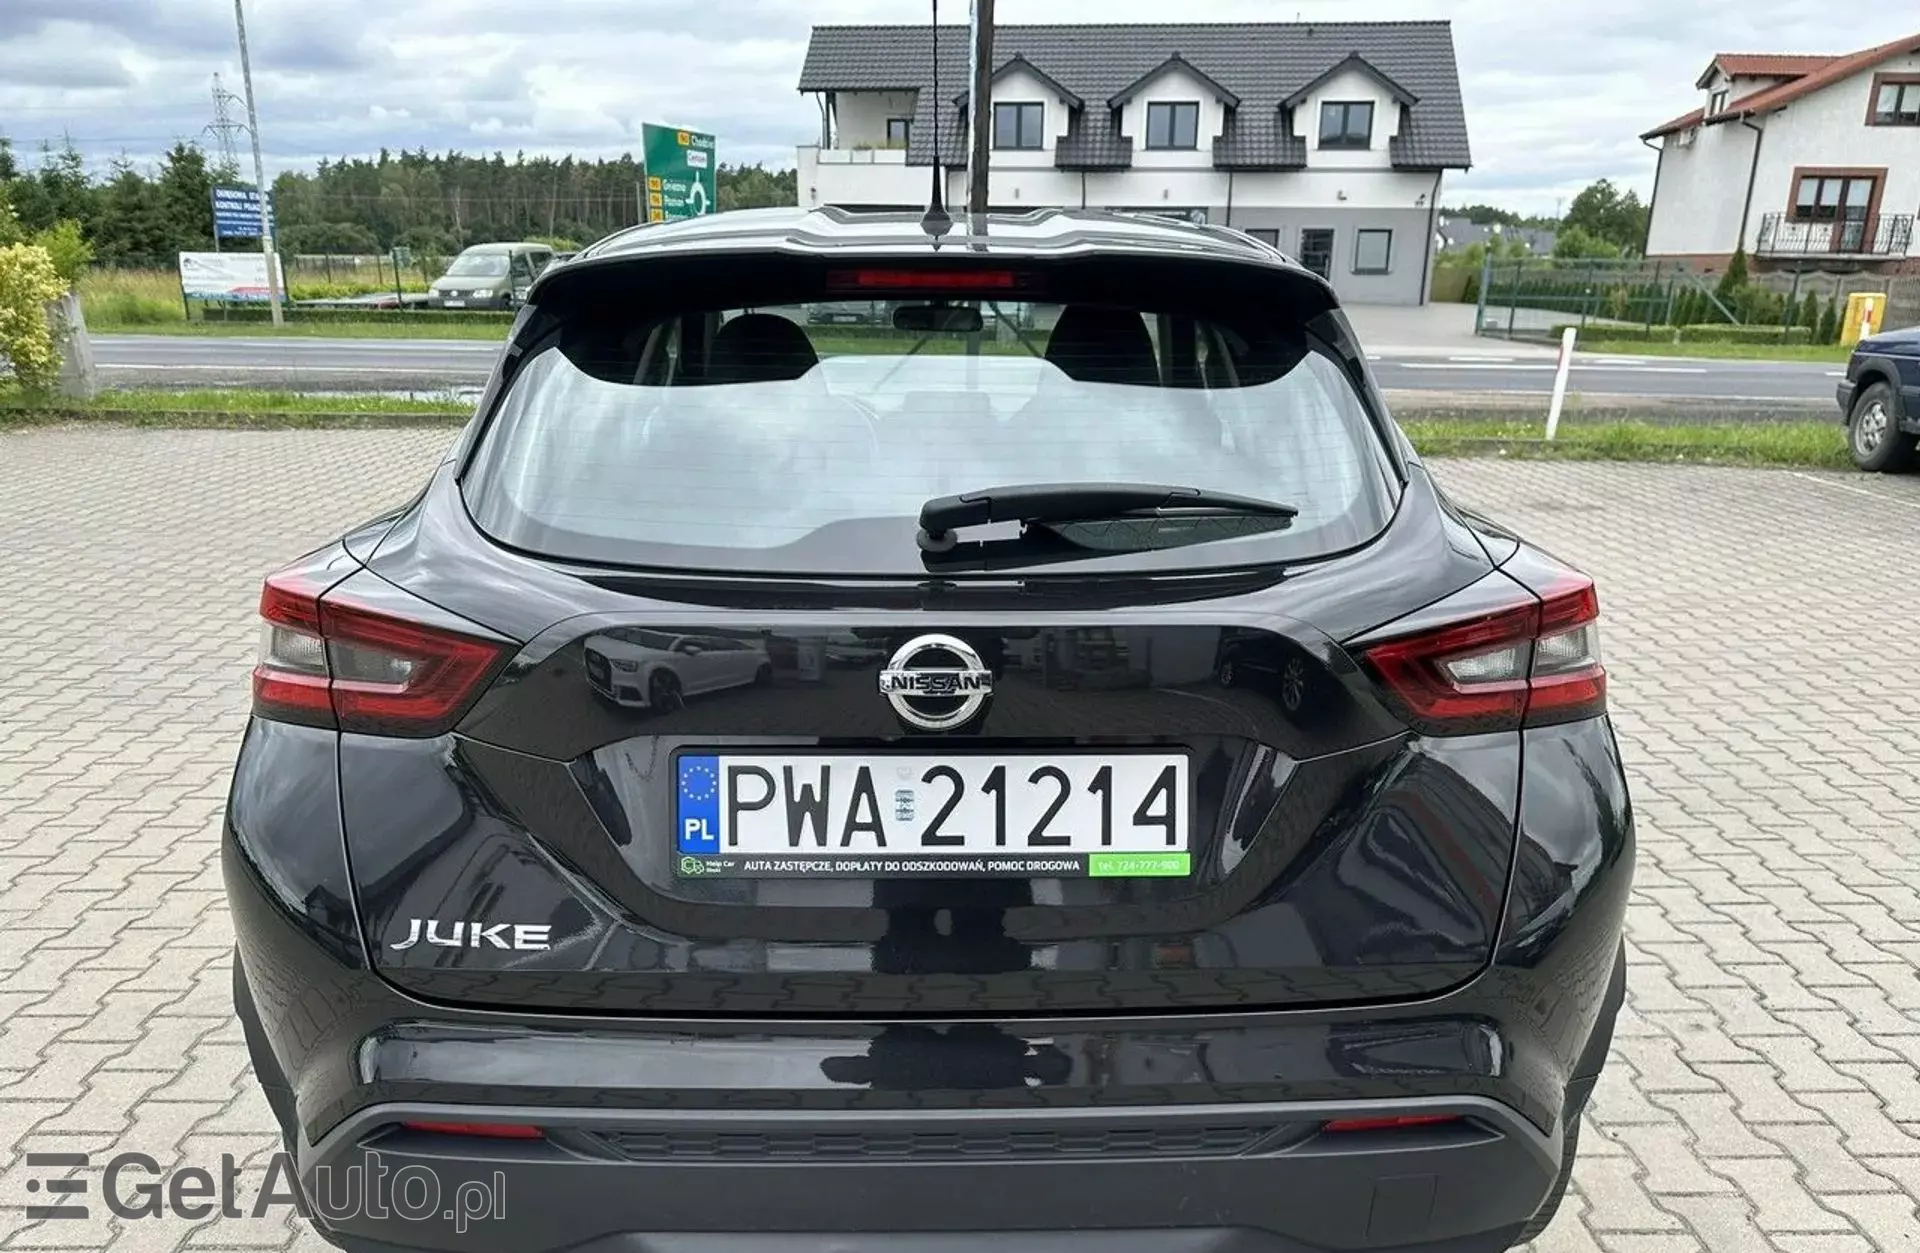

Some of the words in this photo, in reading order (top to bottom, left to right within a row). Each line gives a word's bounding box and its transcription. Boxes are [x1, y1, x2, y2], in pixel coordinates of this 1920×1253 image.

[891, 675, 981, 690] NISSAN
[728, 765, 887, 847] PWA
[921, 765, 1177, 847] 21214
[685, 818, 714, 840] PL
[744, 860, 772, 871] AUTA
[773, 860, 834, 873] ZASTĘPCZE,
[836, 860, 883, 872] DOPŁATY
[885, 860, 900, 871] DO
[902, 858, 985, 872] ODSZKODOWAŃ,
[988, 860, 1024, 871] POMOC
[1027, 860, 1080, 871] DROGOWA
[390, 919, 552, 950] JUKE
